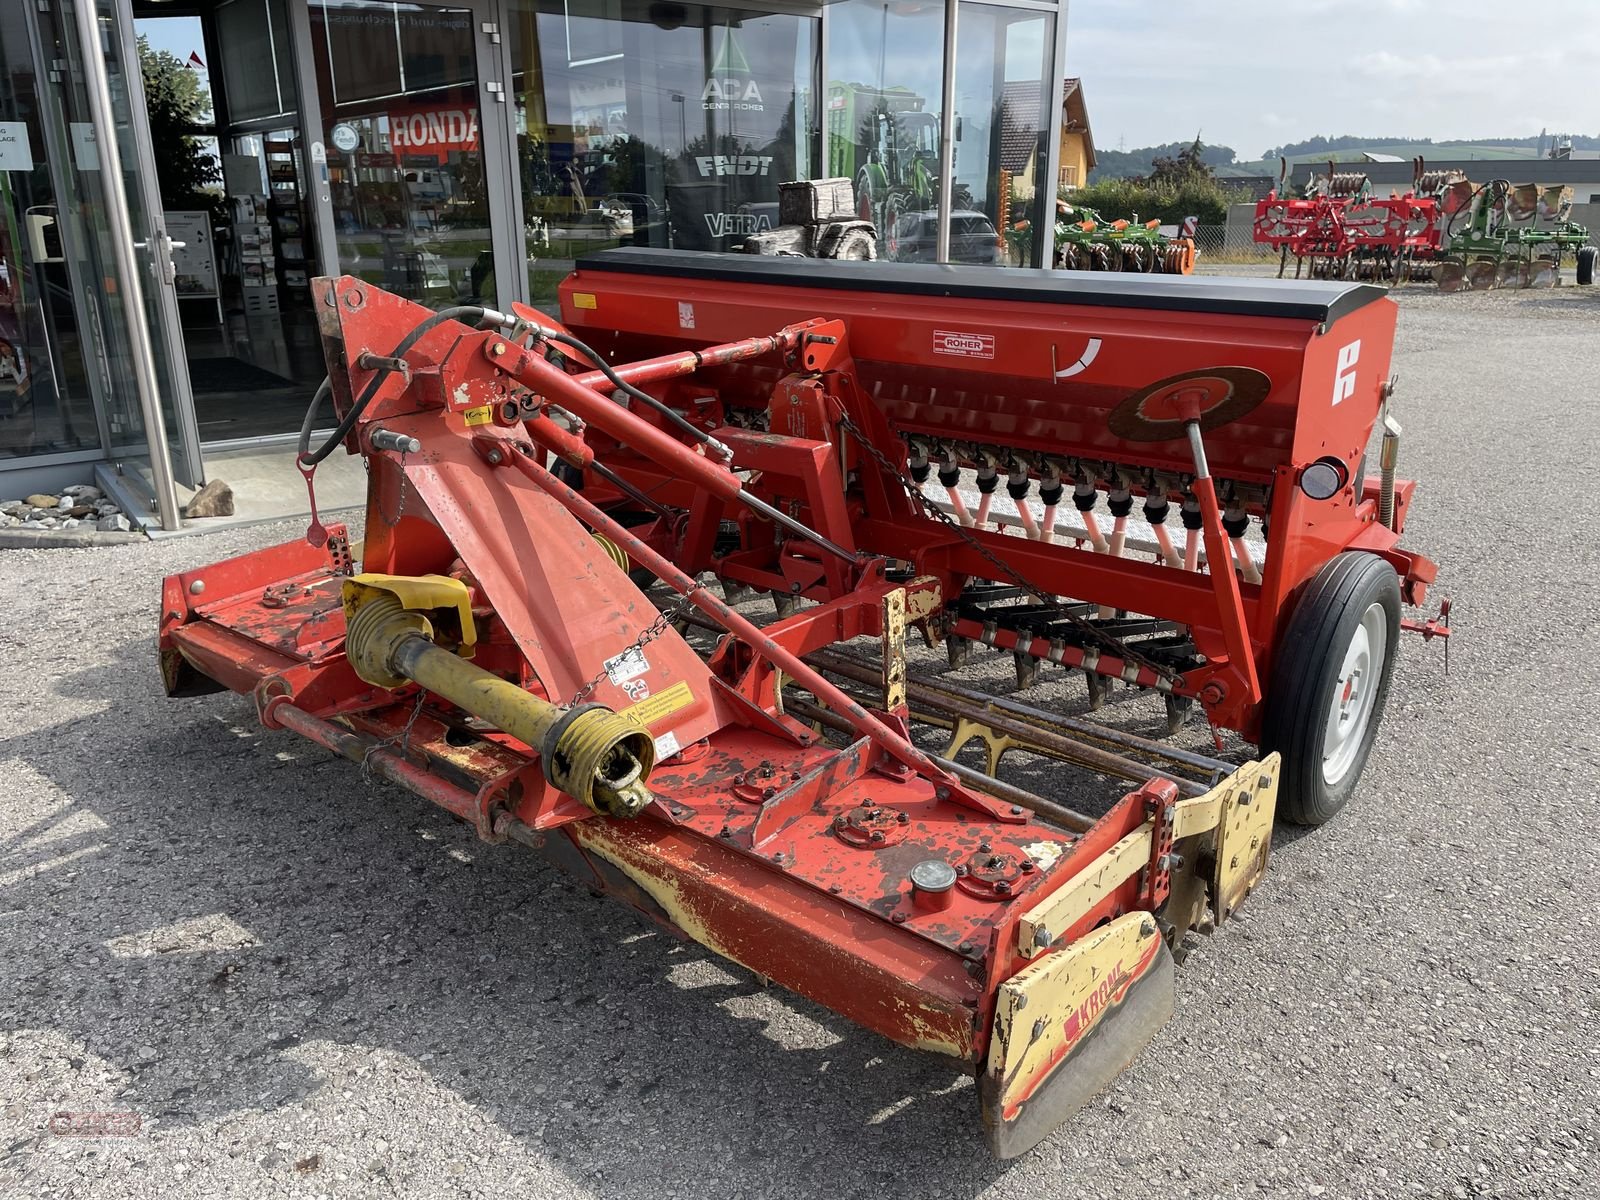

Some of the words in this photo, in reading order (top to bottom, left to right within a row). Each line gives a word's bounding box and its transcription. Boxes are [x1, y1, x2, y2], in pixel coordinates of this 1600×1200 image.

[701, 79, 762, 102] ACA
[704, 212, 772, 238] VLTRA
[946, 339, 981, 350] ROHER
